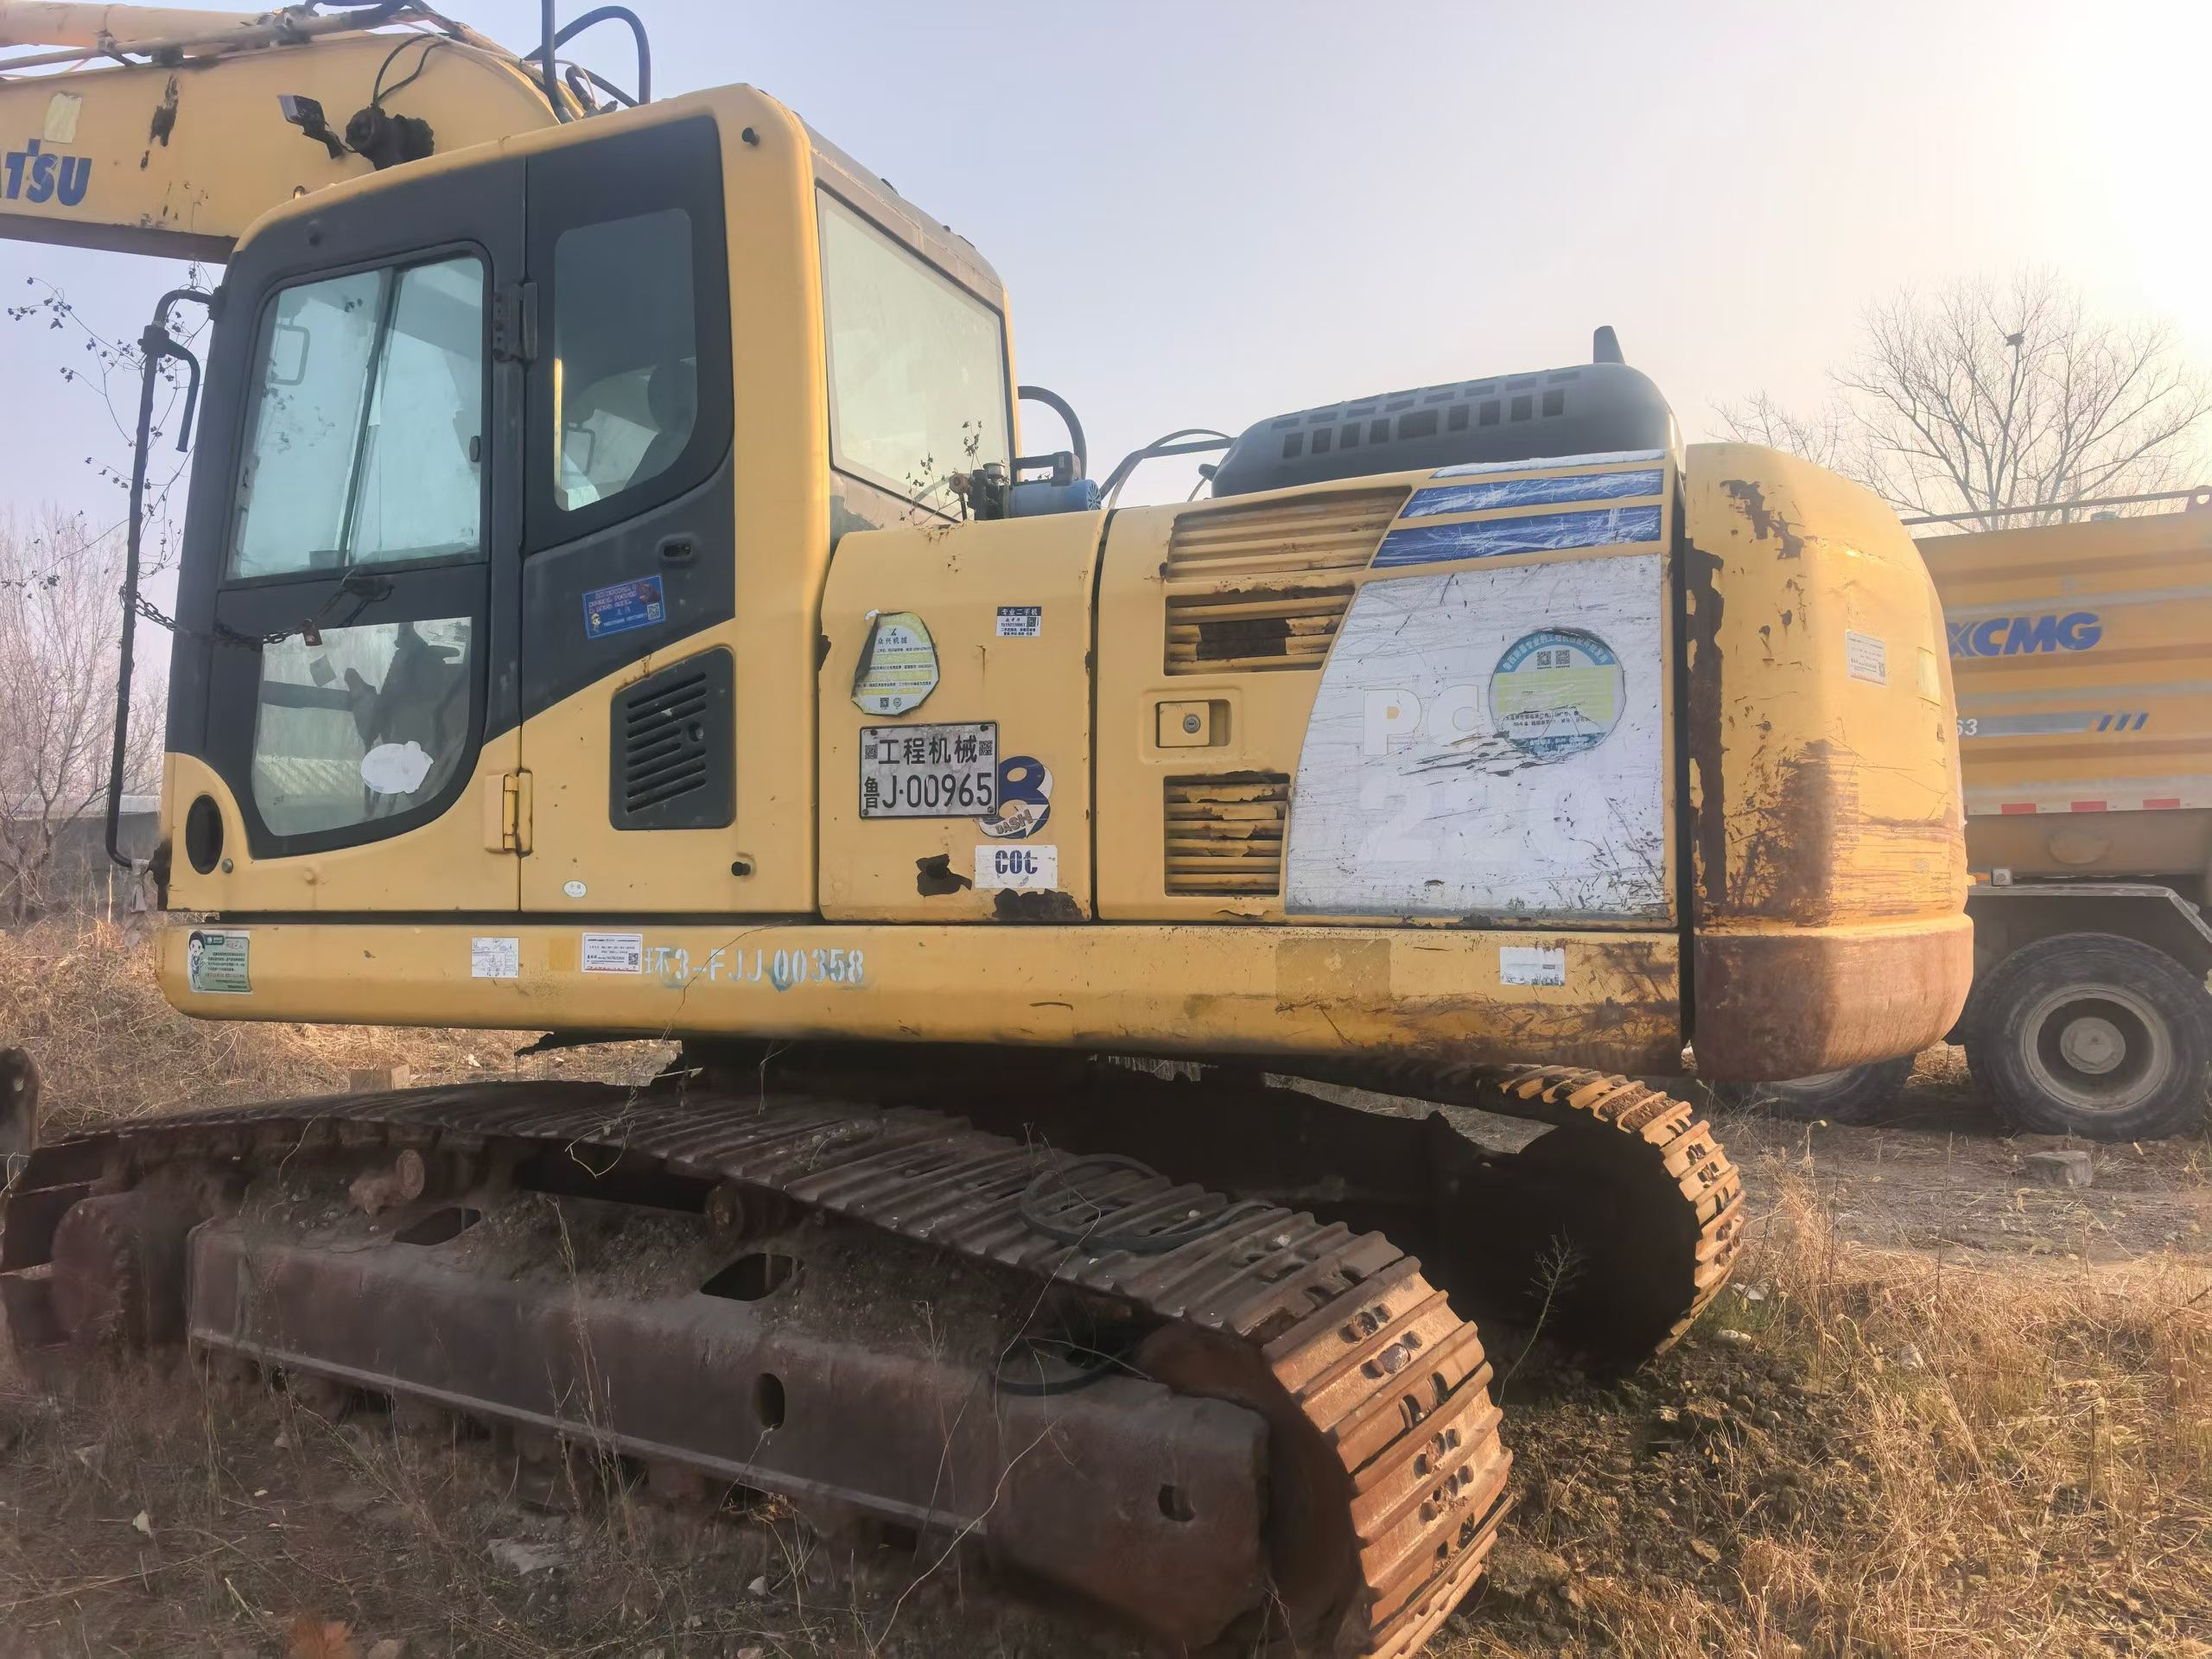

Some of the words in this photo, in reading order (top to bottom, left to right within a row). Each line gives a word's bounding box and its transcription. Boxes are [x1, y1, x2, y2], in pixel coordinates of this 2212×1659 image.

[0, 138, 92, 207] TSU
[1001, 607, 1038, 616] 专业二手机
[1945, 612, 2102, 658] XCMG
[1363, 683, 1485, 757] PC
[878, 734, 978, 765] 工程机械
[995, 808, 1033, 835] DASH
